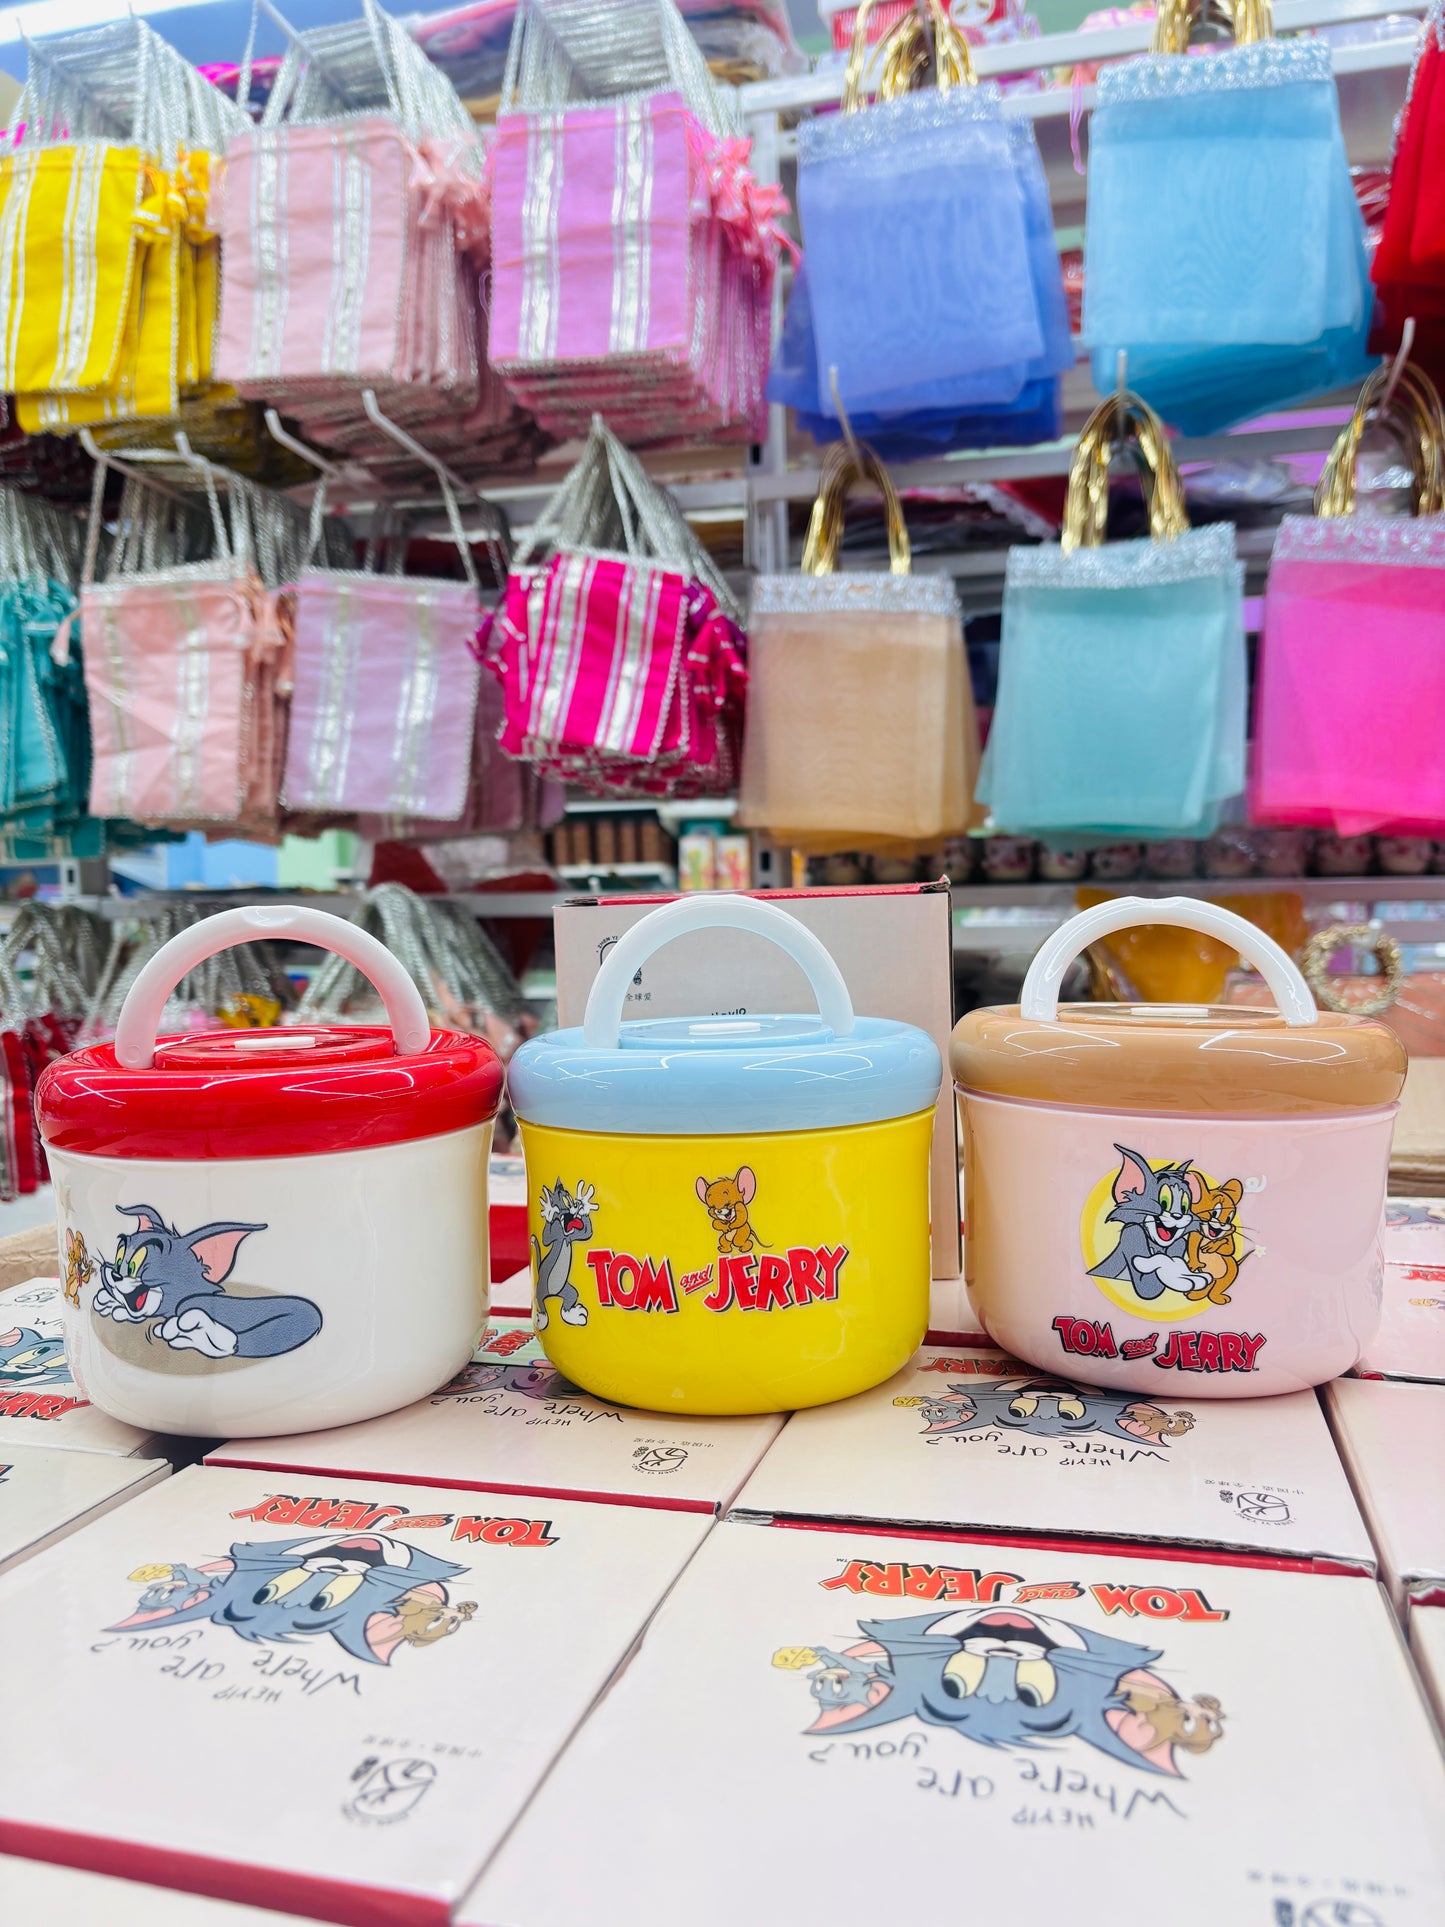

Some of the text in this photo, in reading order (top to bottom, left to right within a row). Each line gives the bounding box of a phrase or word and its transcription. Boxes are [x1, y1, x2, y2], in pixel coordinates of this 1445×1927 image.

[586, 1243, 850, 1314] TOM and JERRY
[1052, 1316, 1119, 1360] TOM
[1122, 1333, 1160, 1361] and
[1152, 1331, 1267, 1373] JERRY
[483, 1405, 528, 1418] are
[543, 1402, 624, 1423] Where
[997, 1444, 1048, 1457] are
[1058, 1439, 1171, 1463] Where
[229, 1494, 561, 1548] TOM and JERRY
[817, 1559, 1026, 1604] JERRY
[1011, 1581, 1086, 1604] and
[1089, 1583, 1231, 1622] TOM
[160, 1655, 226, 1680] are
[252, 1649, 362, 1697] Where
[916, 1766, 996, 1799] are
[1012, 1757, 1189, 1819] Where
